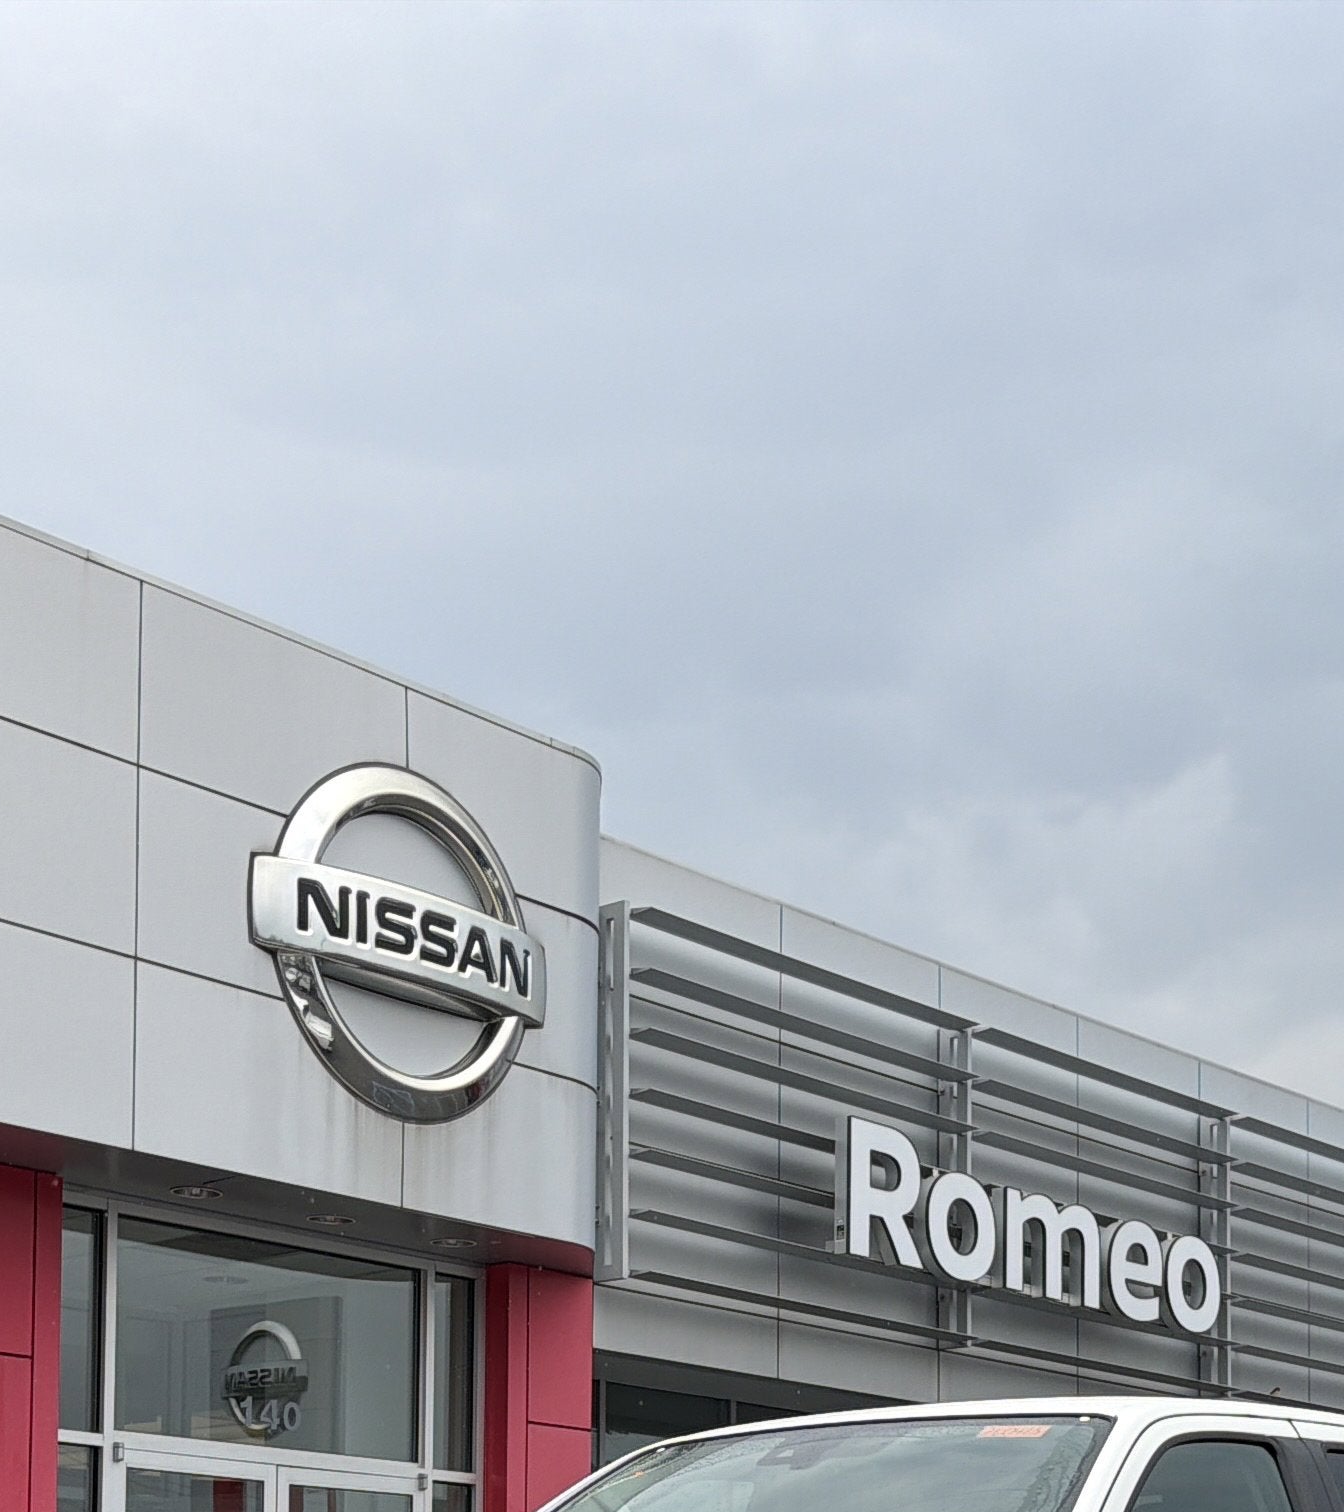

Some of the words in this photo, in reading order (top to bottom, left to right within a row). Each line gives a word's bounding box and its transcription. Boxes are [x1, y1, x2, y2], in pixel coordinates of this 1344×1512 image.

[296, 877, 532, 999] NISSAN
[846, 1114, 1221, 1333] Romeo
[240, 1395, 302, 1432] 140
